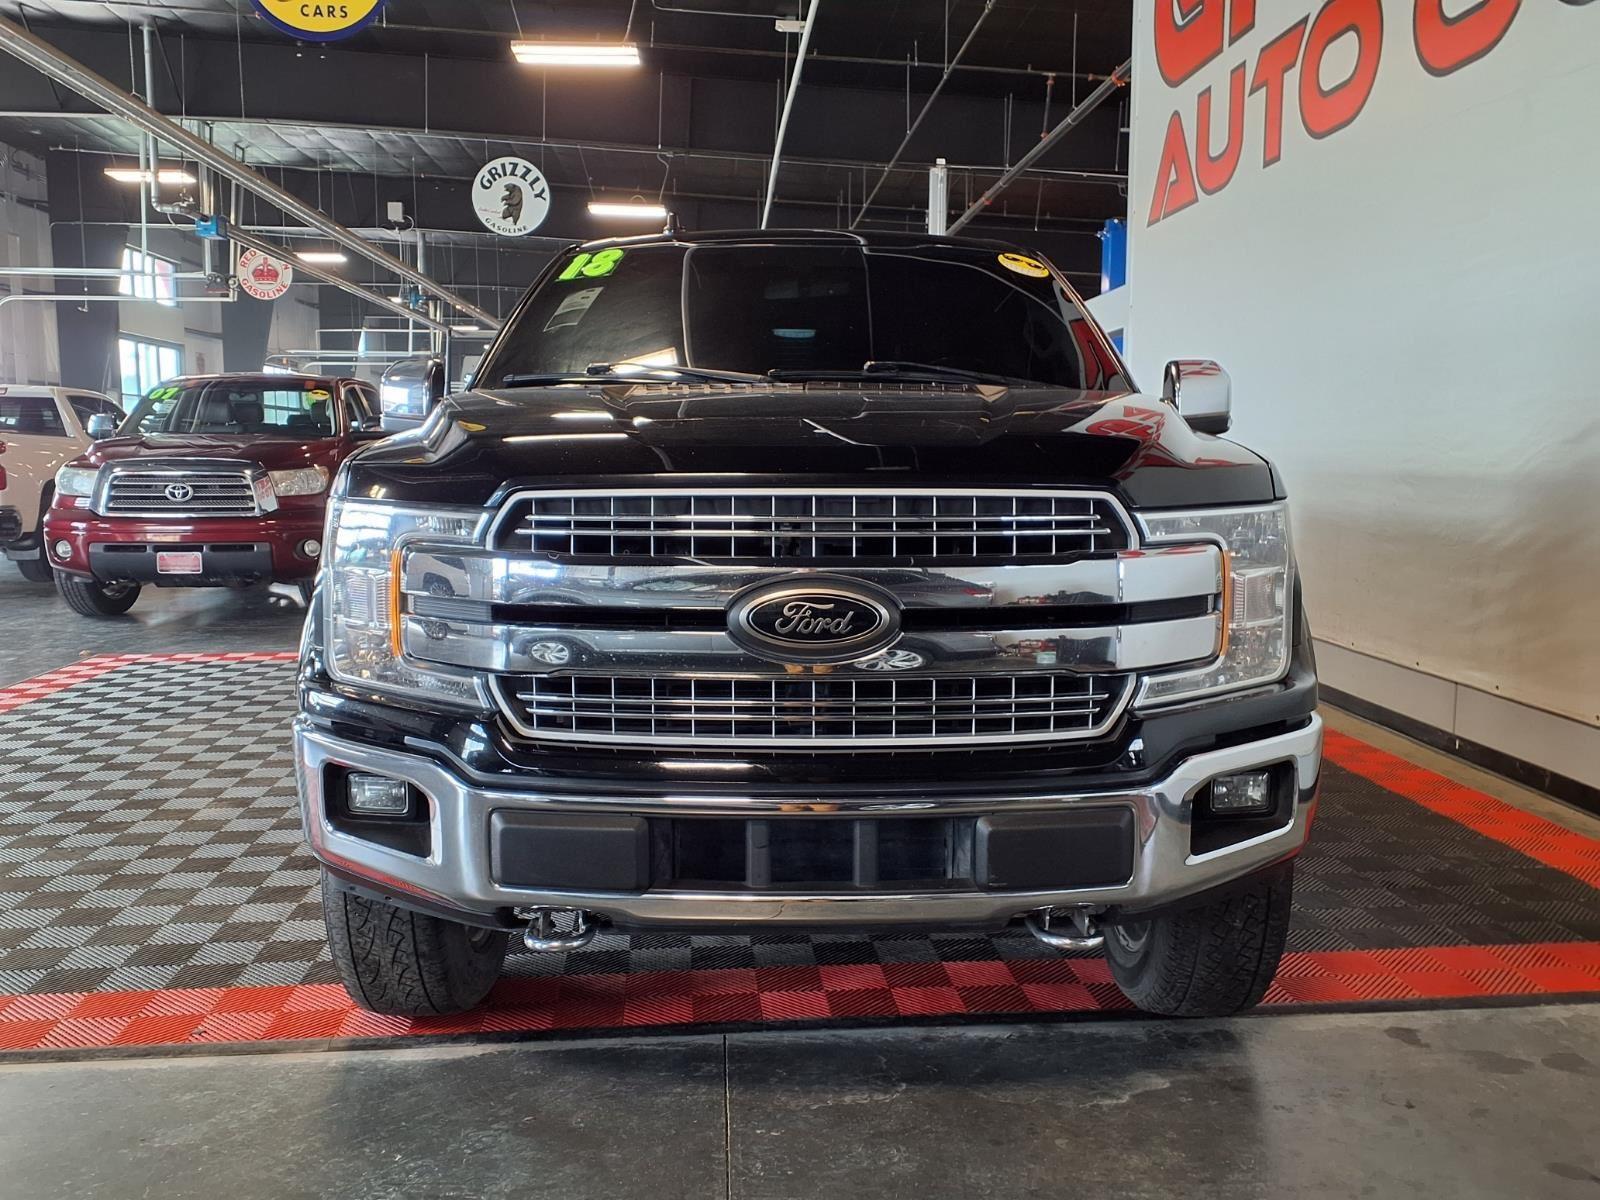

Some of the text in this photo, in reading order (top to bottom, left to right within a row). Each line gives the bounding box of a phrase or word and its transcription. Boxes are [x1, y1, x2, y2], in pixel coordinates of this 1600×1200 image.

[299, 3, 349, 19] CARS
[1147, 0, 1384, 228] AUTO
[480, 161, 547, 202] GRIZZLY
[485, 217, 529, 234] GASOLINE
[240, 249, 257, 268] RED
[557, 248, 624, 281] 18
[241, 278, 288, 298] GASOLINE
[774, 601, 854, 634] Ford
